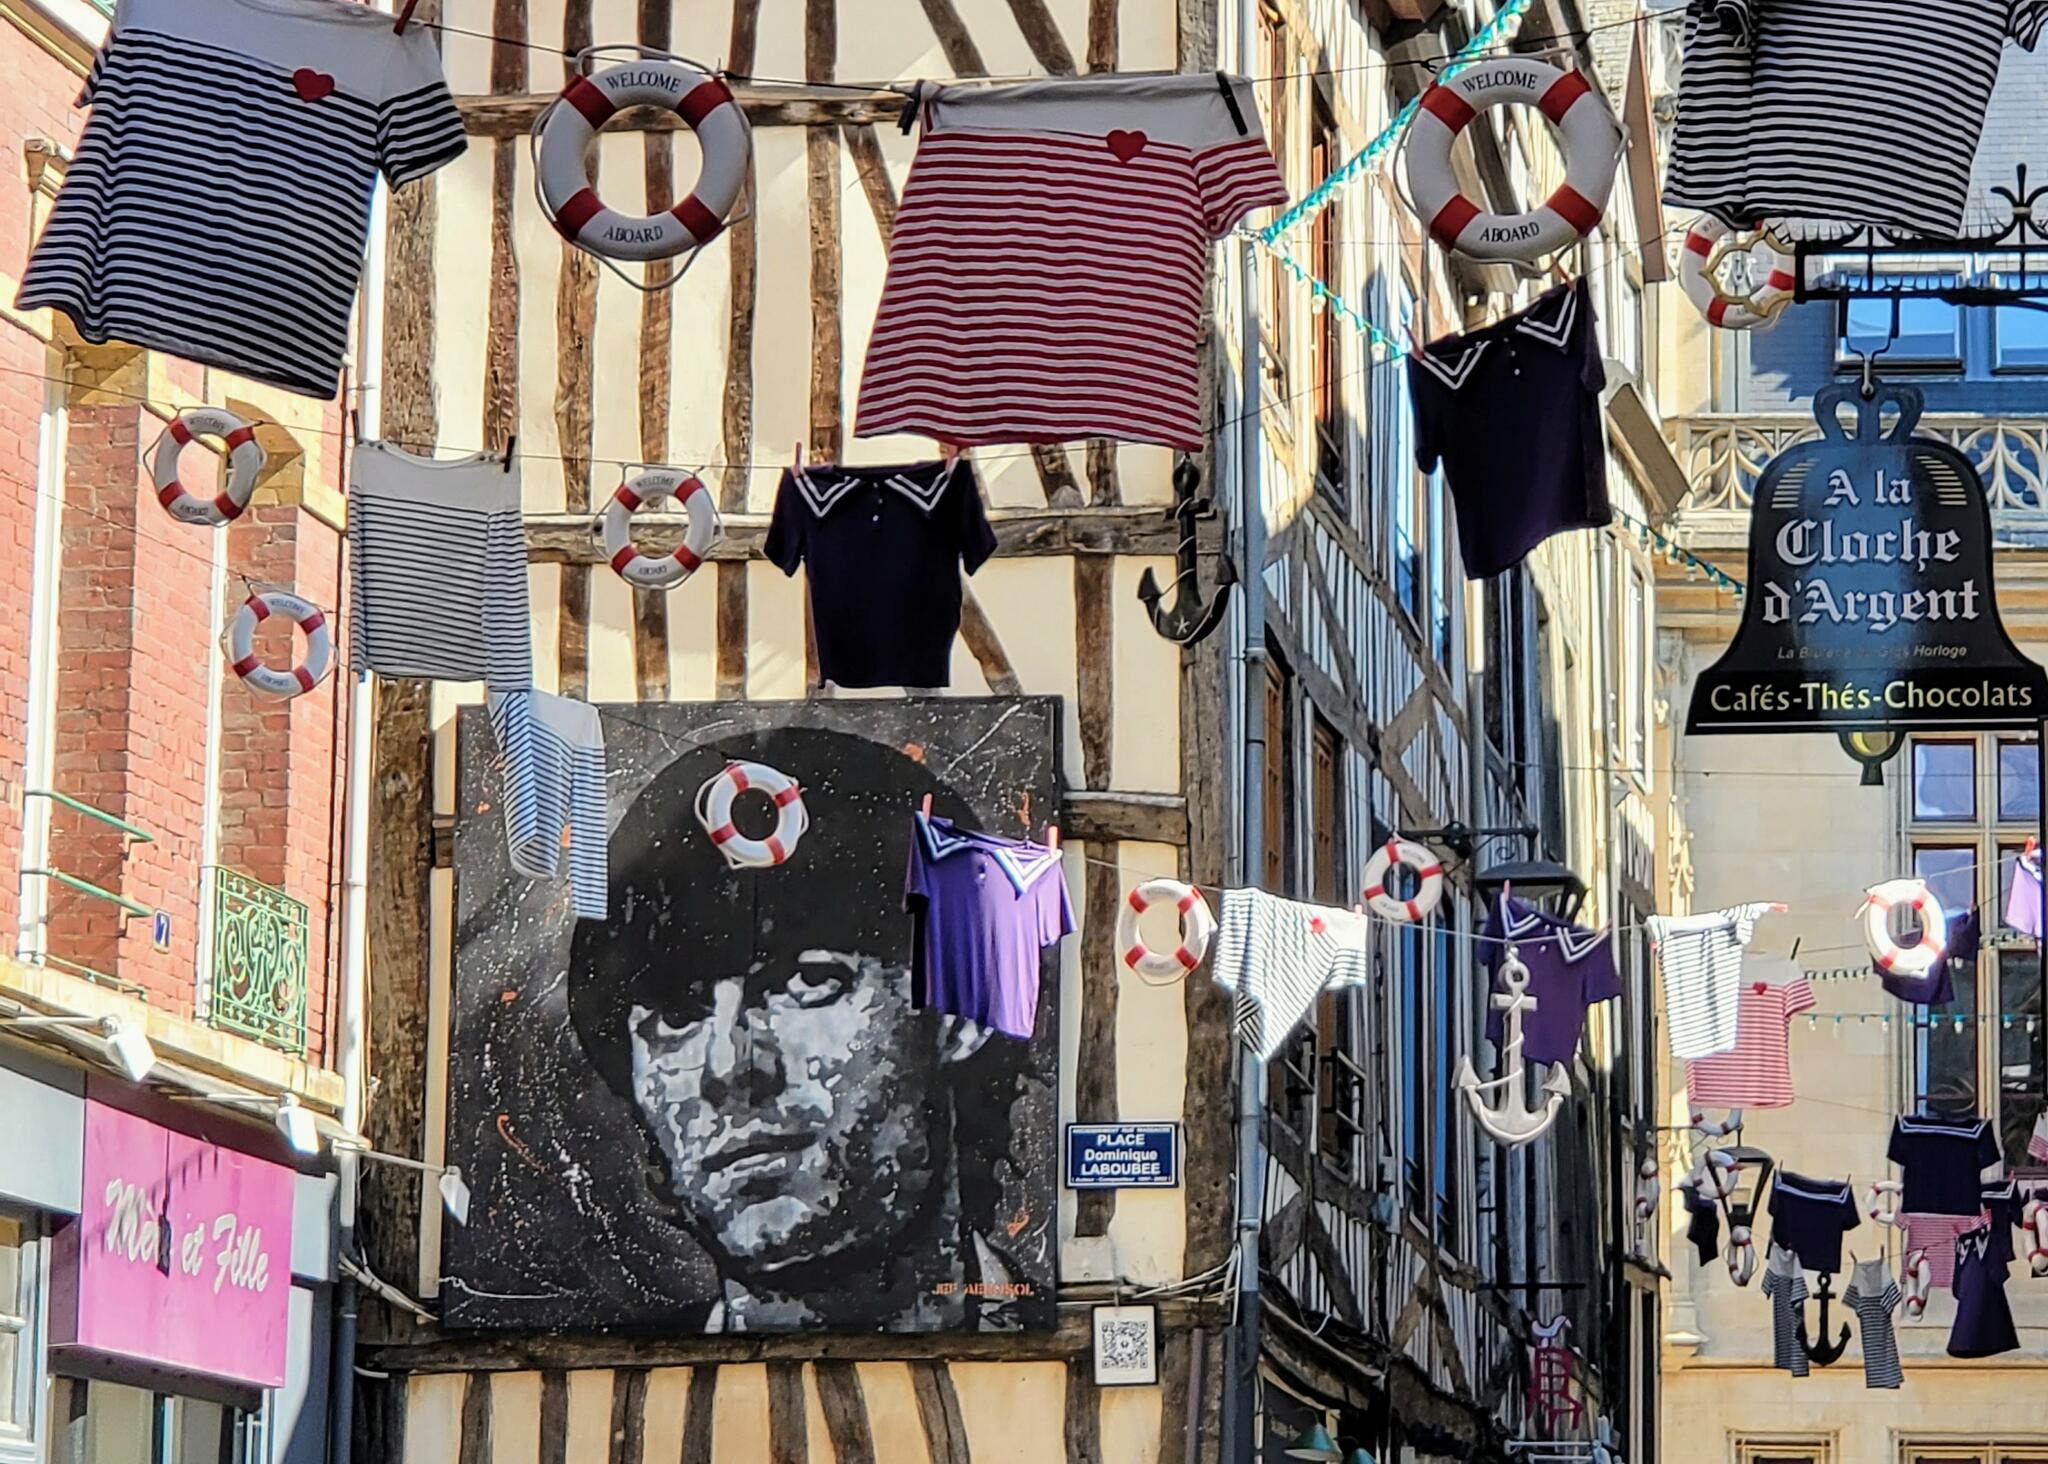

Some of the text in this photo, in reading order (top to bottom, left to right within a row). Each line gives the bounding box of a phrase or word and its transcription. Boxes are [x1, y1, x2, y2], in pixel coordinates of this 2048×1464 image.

[605, 71, 681, 93] WELCOME
[1462, 70, 1539, 92] WELCOME
[603, 225, 664, 243] ABOARD
[1479, 222, 1540, 243] ABOARD
[1823, 468, 1912, 506] A la
[1775, 517, 1962, 573] Cloche
[1761, 578, 1981, 633] d'Argent
[1777, 646, 1795, 660] La
[1913, 644, 1968, 660] Horloge
[1096, 1133, 1146, 1146] PLACE
[1084, 1148, 1158, 1162] Dominique
[1081, 1162, 1161, 1176] LABOUBEE
[212, 1212, 269, 1295] Fille
